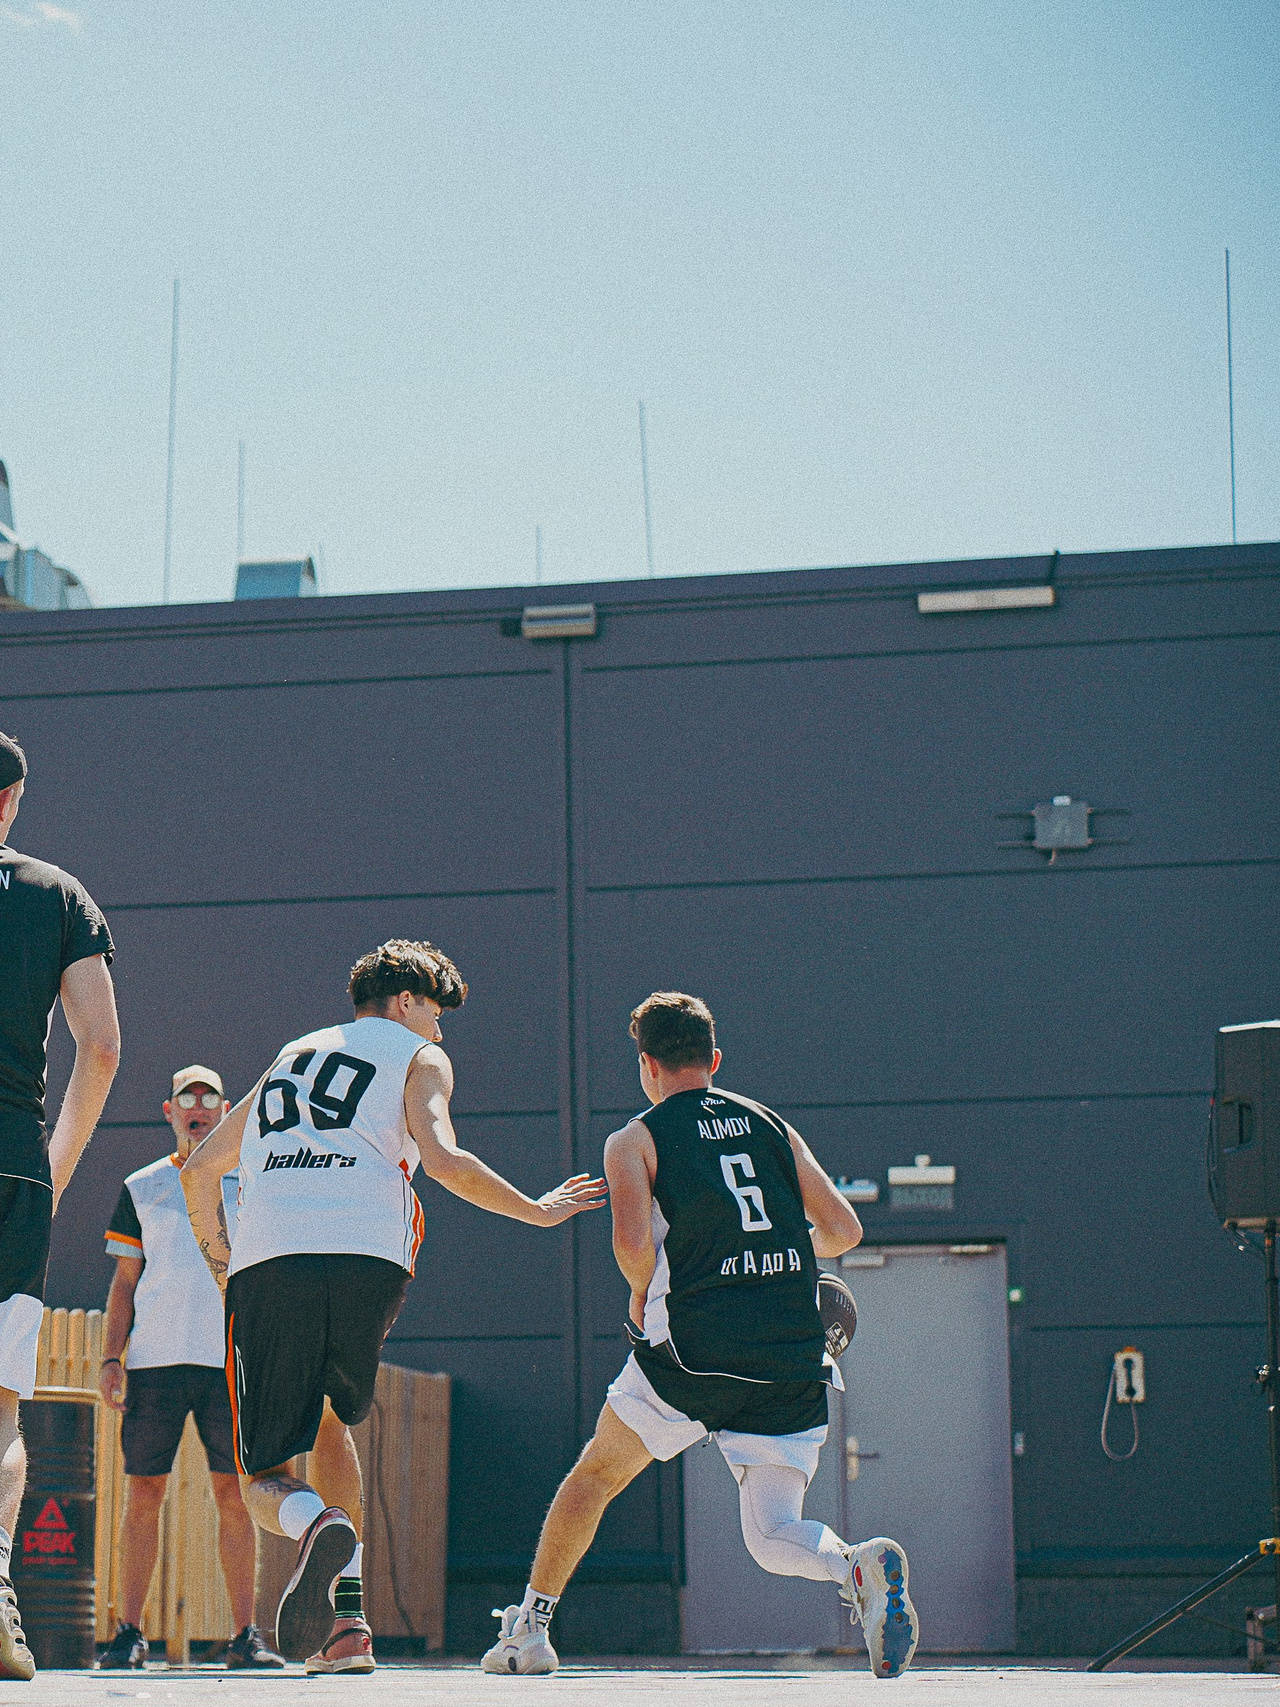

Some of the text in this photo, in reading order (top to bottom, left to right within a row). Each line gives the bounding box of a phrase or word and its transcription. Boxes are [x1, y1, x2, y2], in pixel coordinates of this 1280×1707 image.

[257, 1049, 377, 1139] 69
[697, 1116, 751, 1140] ALIMOV
[262, 1147, 357, 1173] ballers
[720, 1153, 773, 1232] 6
[744, 1250, 757, 1274] А
[787, 1248, 801, 1272] Я
[23, 1531, 76, 1553] PEAK
